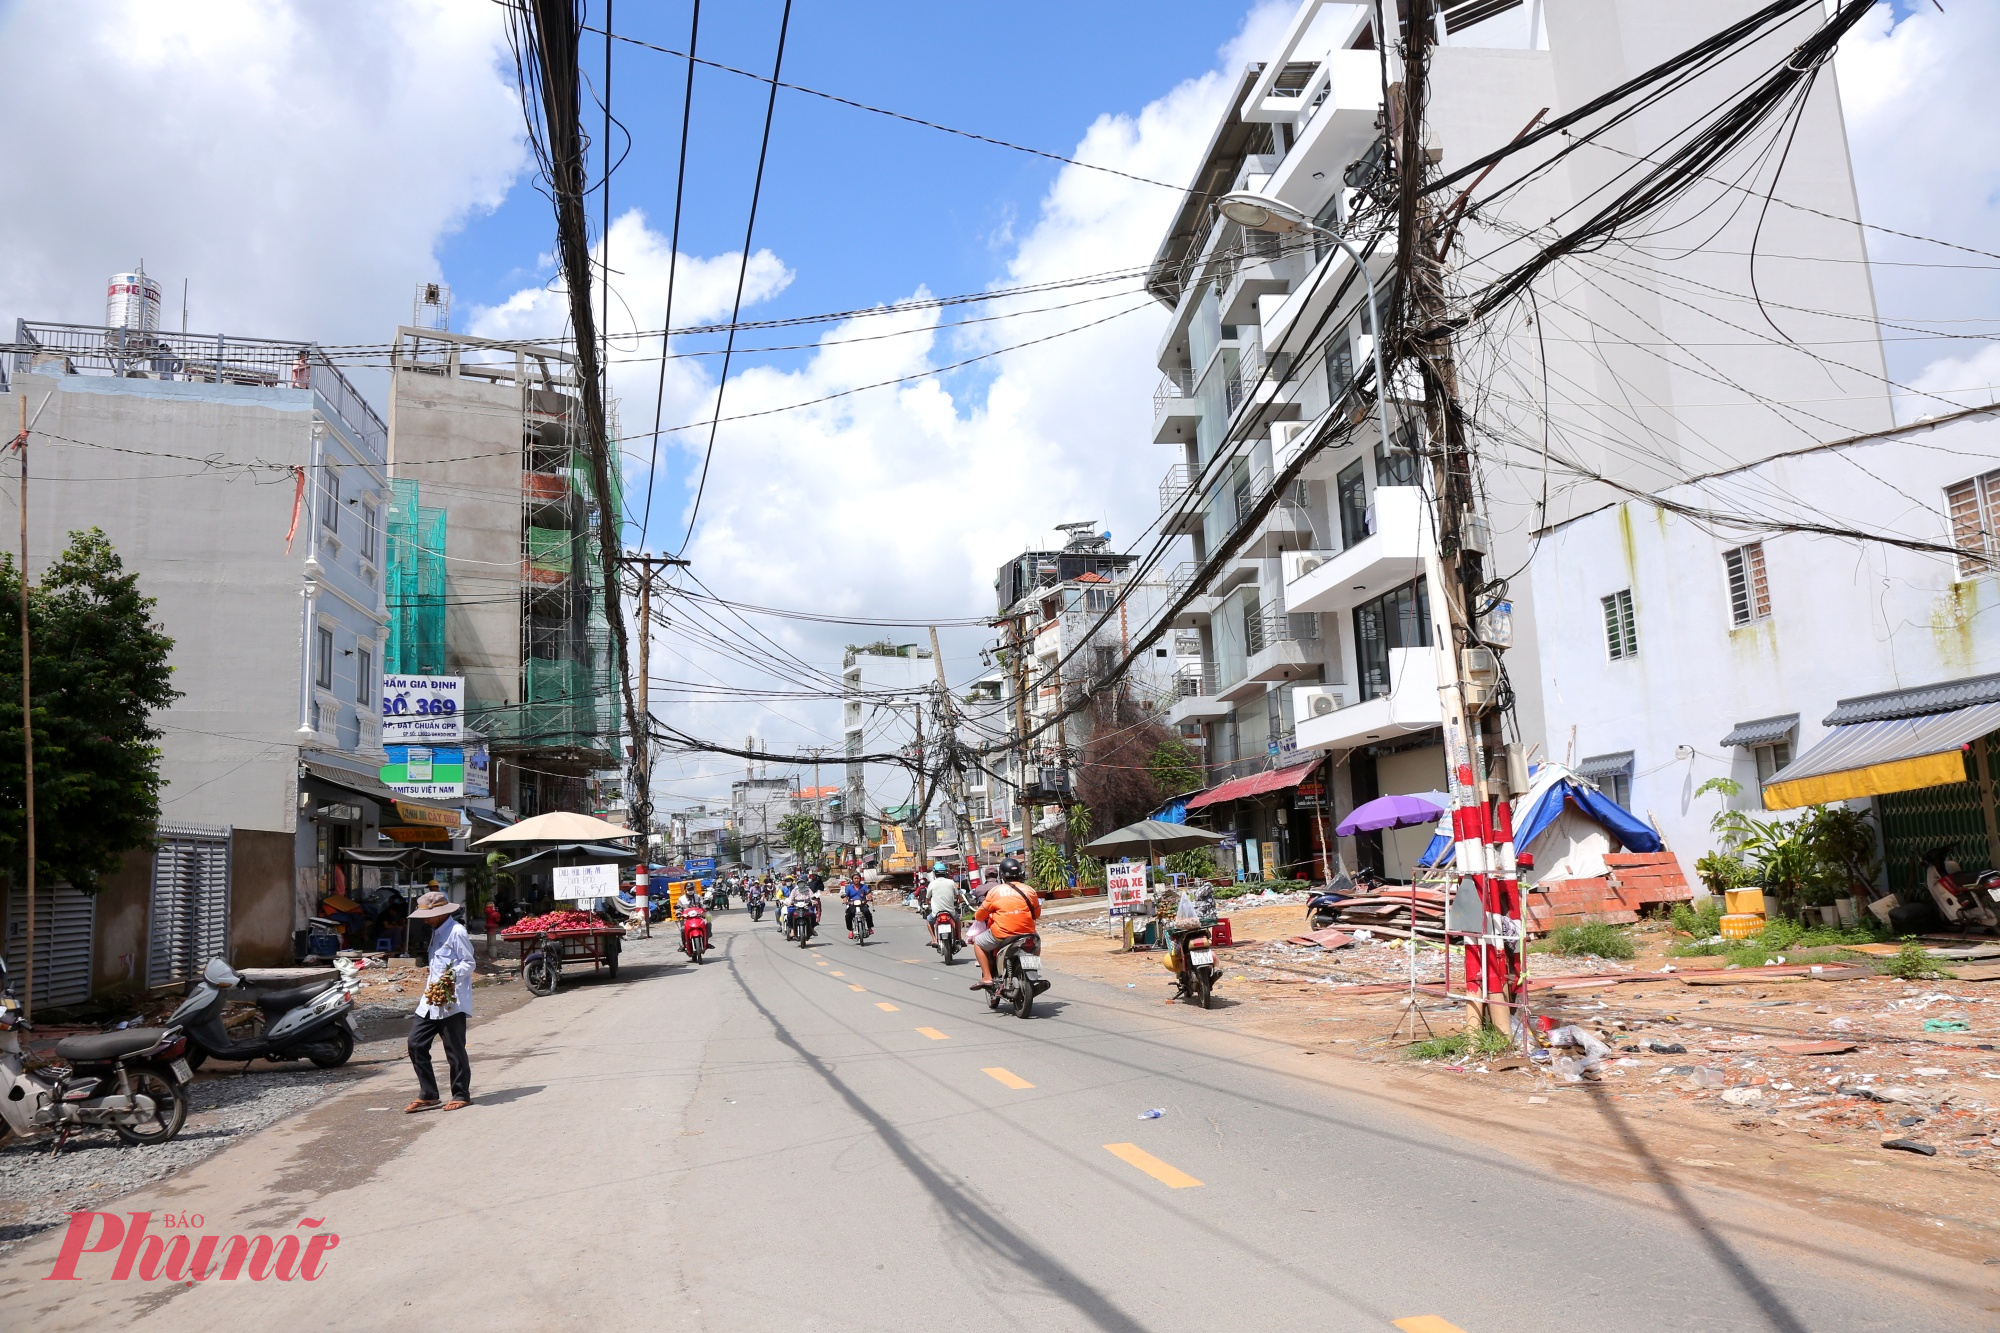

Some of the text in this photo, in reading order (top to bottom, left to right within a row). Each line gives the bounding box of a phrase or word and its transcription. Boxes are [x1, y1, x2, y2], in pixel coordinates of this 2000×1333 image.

[409, 680, 427, 690] GIA
[431, 681, 457, 692] ĐỊNH
[415, 698, 456, 716] 369
[421, 785, 438, 794] VIỆT
[1131, 877, 1144, 887] XE
